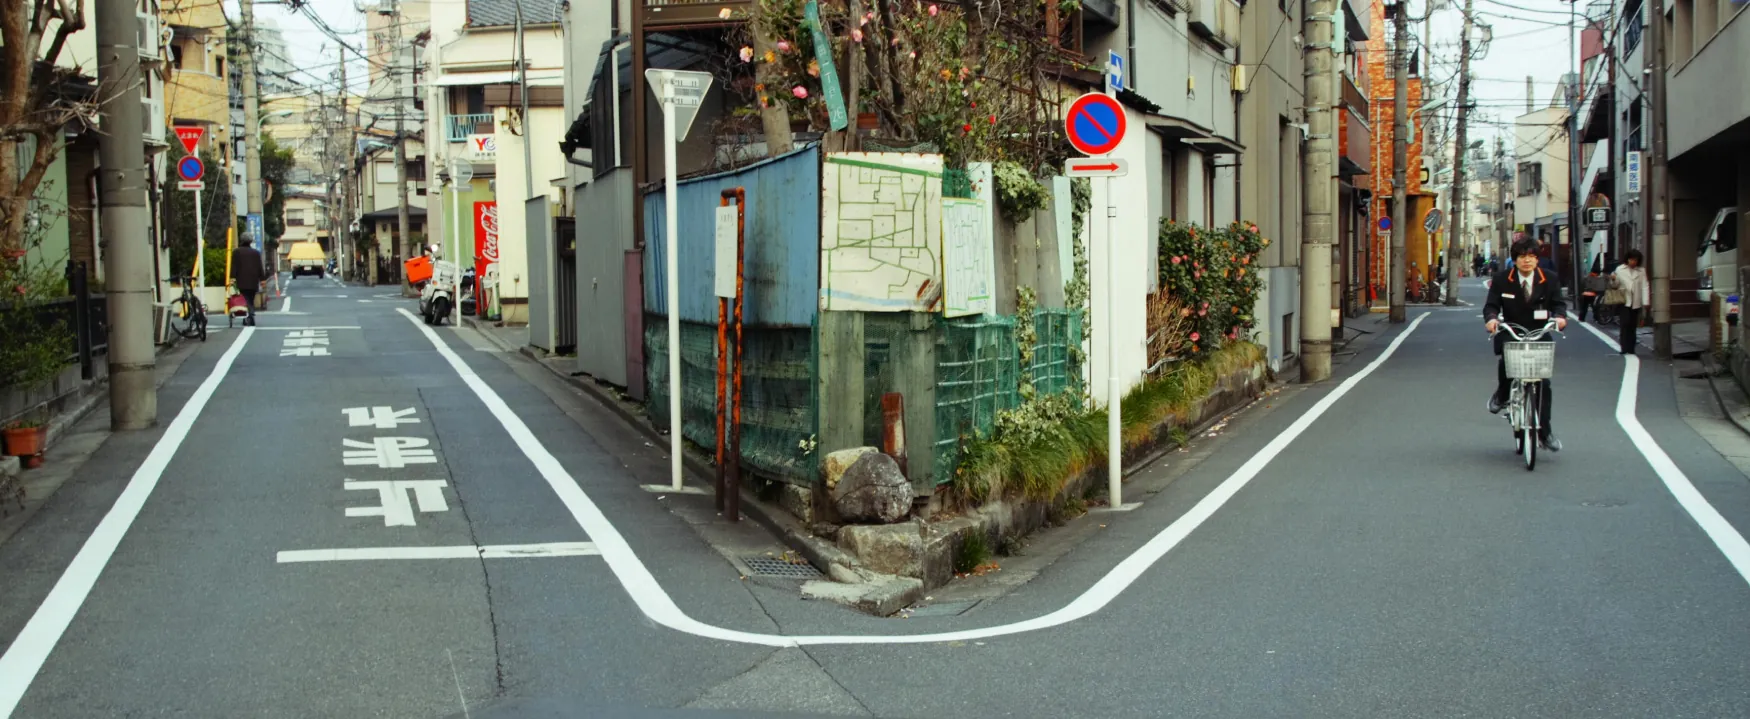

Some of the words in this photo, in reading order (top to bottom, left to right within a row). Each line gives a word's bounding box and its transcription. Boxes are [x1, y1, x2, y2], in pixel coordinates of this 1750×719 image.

[280, 330, 332, 356] 止まれ
[341, 406, 449, 526] 止まれ
